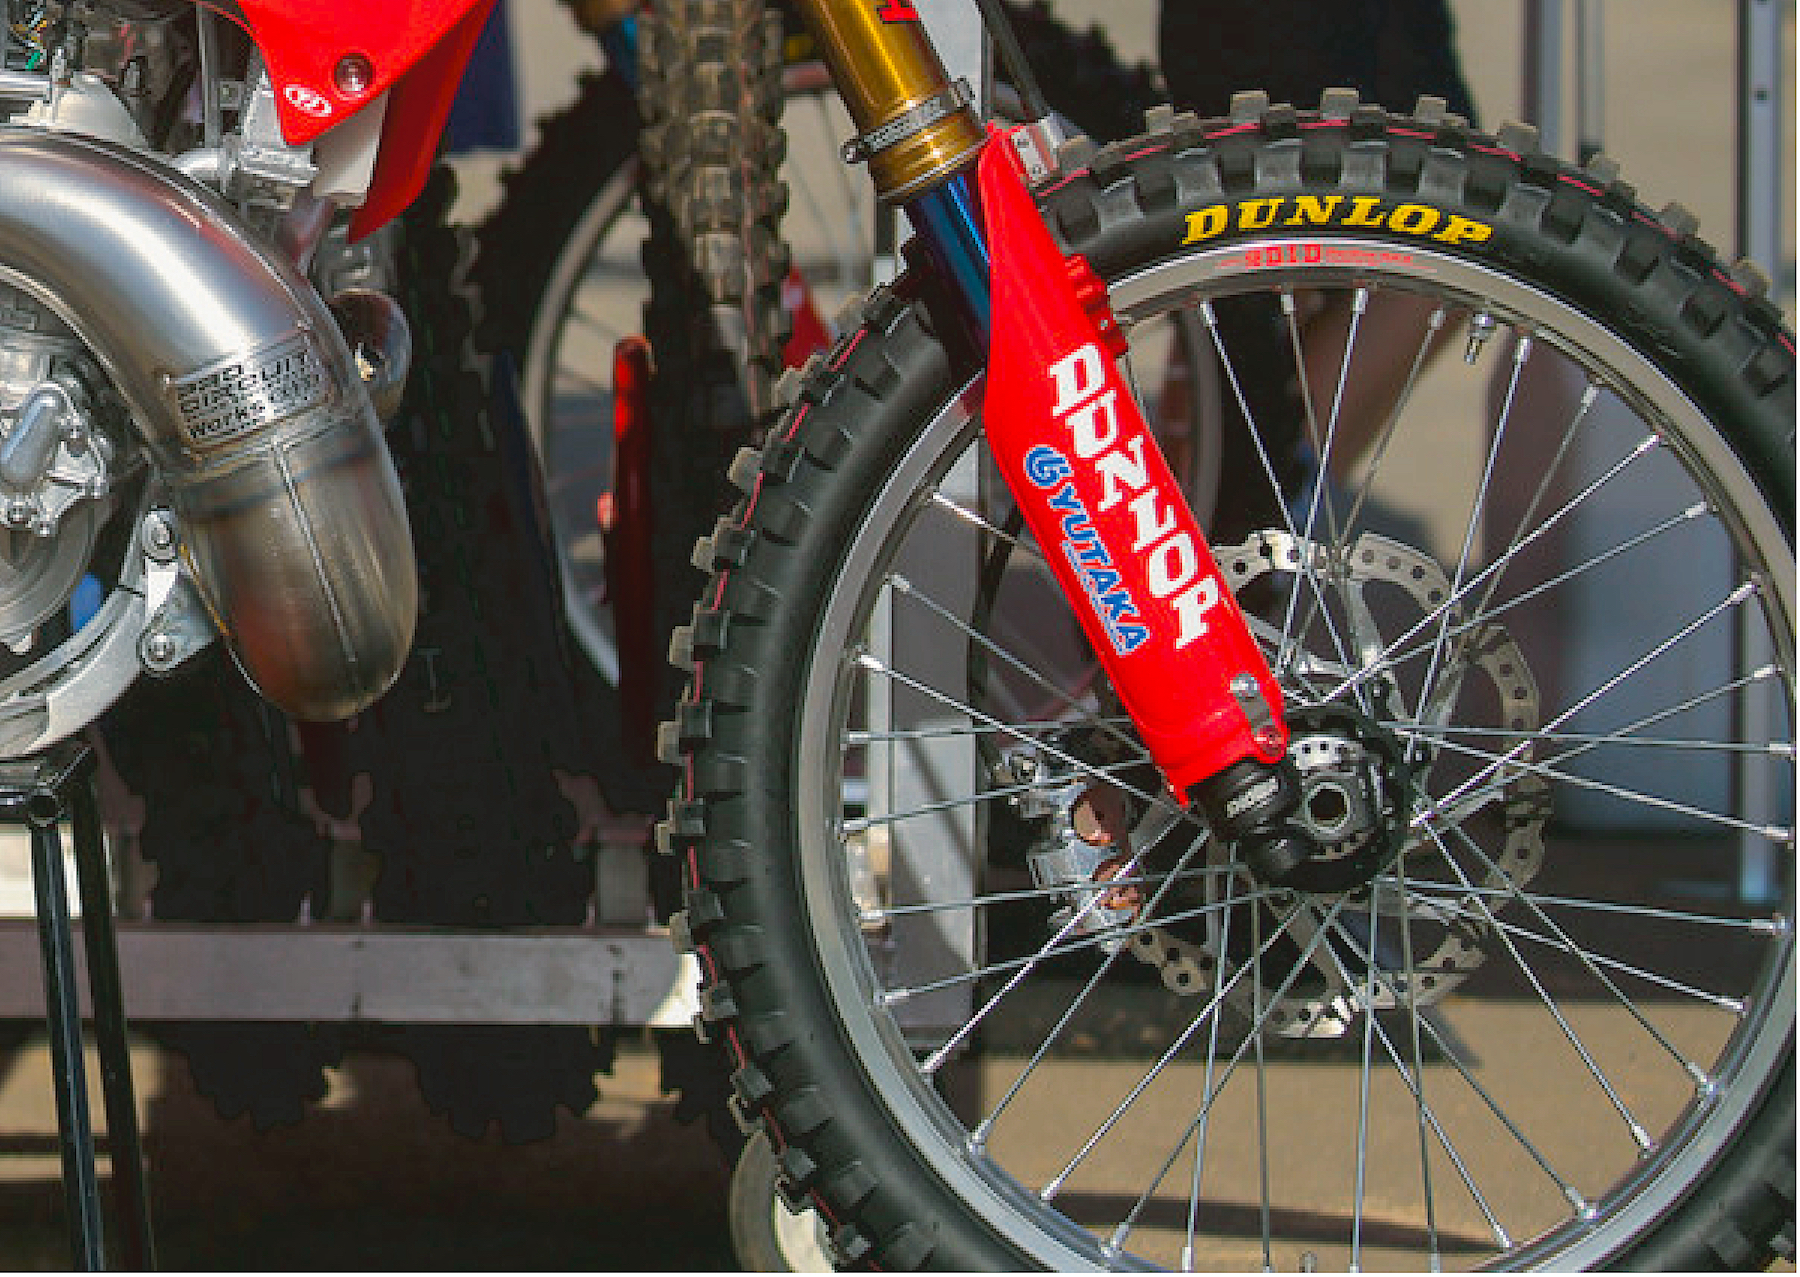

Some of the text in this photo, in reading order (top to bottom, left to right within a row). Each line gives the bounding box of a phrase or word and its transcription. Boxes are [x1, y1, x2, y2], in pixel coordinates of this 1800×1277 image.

[1180, 195, 1494, 245] DUNLOP
[1047, 481, 1151, 656] YUTAKA
[1048, 343, 1219, 650] DUNLOP
